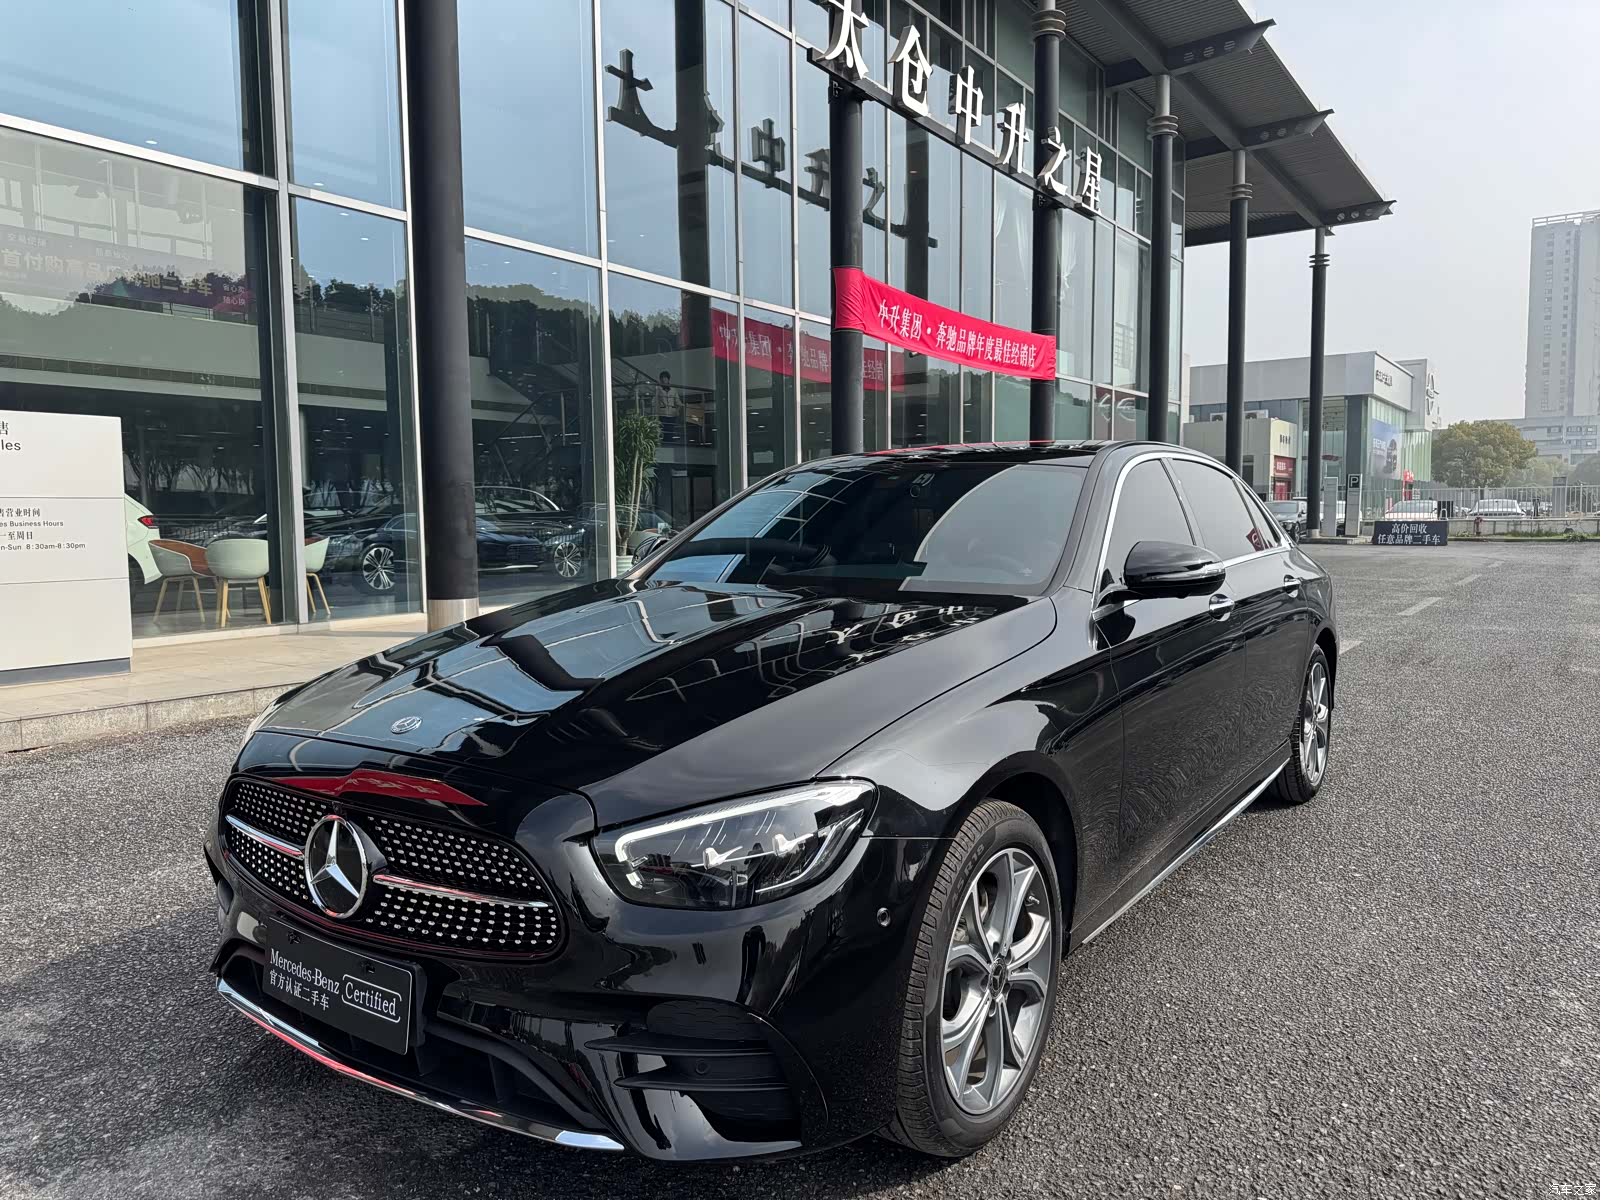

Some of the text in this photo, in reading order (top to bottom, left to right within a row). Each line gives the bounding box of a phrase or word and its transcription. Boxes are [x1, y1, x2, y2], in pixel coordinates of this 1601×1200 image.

[817, 0, 1102, 216] 太仓中升之星
[1, 439, 21, 451] les
[1350, 476, 1359, 487] P
[1391, 523, 1428, 534] 高价回收
[1377, 533, 1441, 545] 任意品牌二手车
[269, 948, 397, 1017] Mercedes-Benz Certified
[269, 969, 330, 1011] 官方认证二手车
